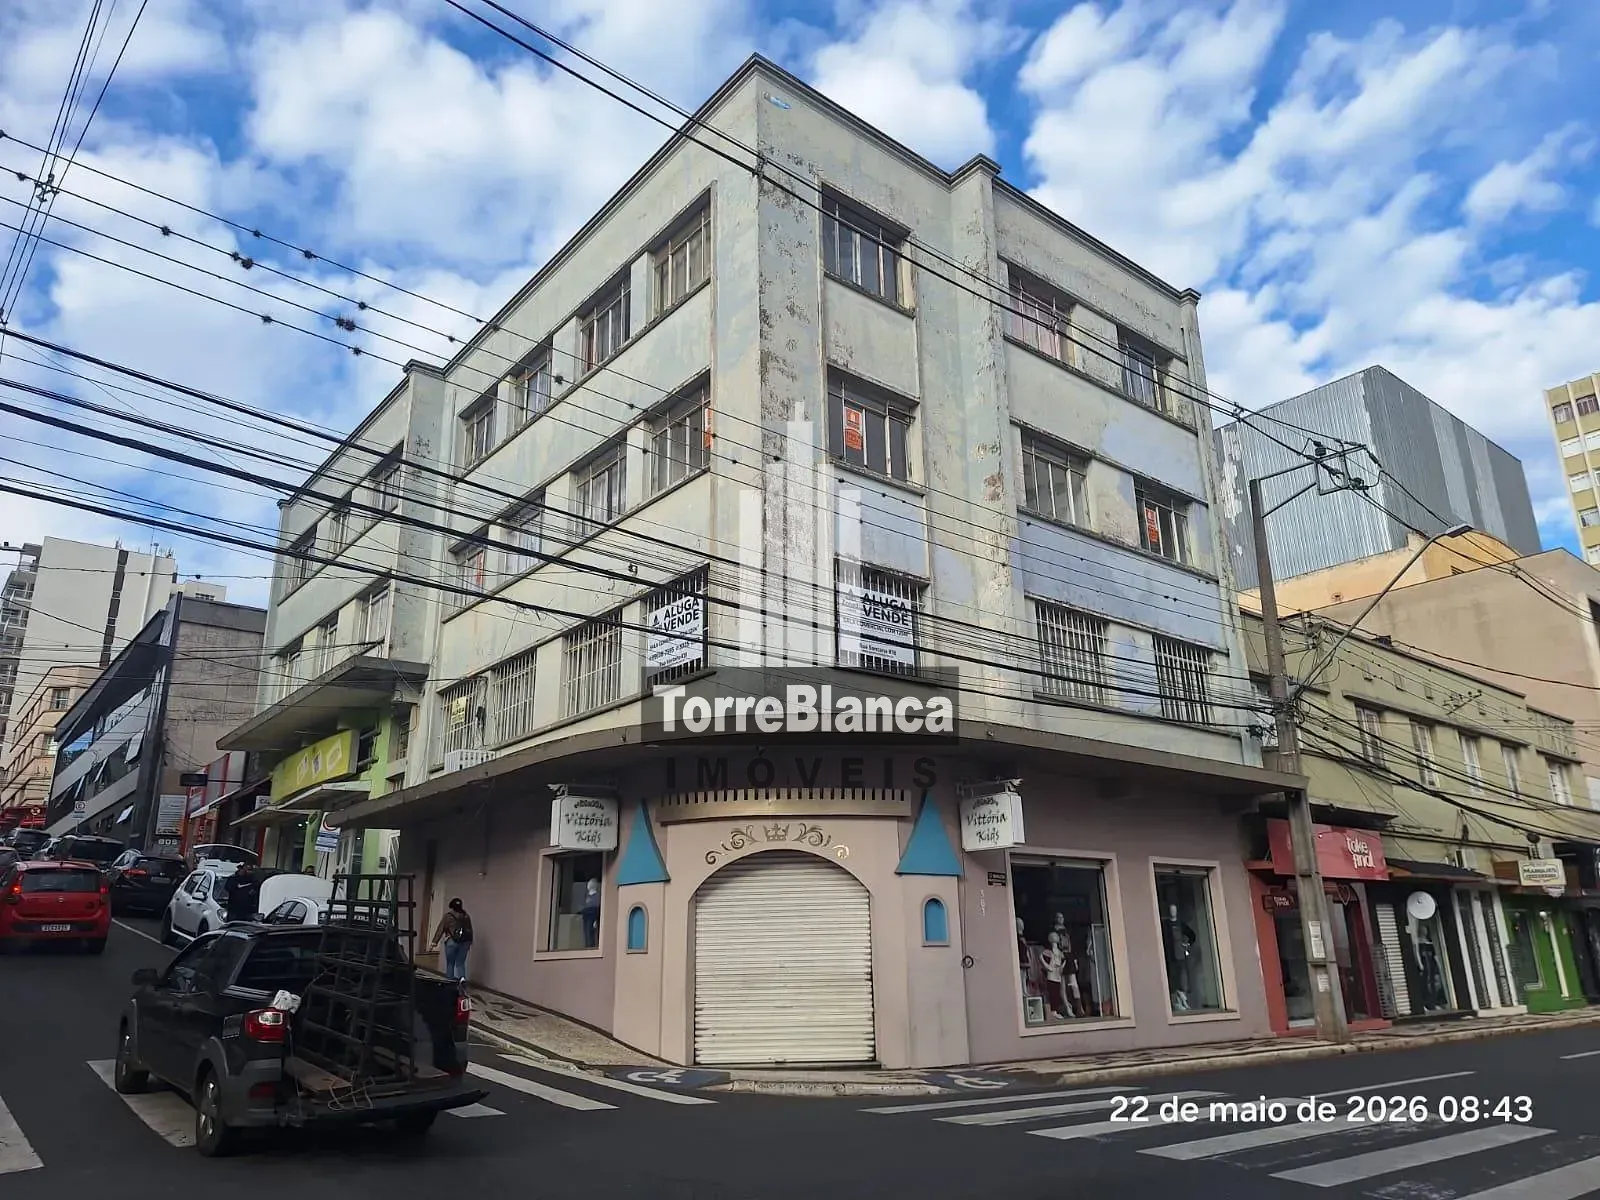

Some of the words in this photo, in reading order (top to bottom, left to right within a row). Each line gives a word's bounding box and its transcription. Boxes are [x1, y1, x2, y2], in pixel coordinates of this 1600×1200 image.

[663, 597, 699, 620] ALUGA
[863, 593, 908, 612] ALUGA
[664, 608, 699, 632] VENDE
[863, 605, 909, 626] VENDE
[976, 828, 1000, 845] Kids
